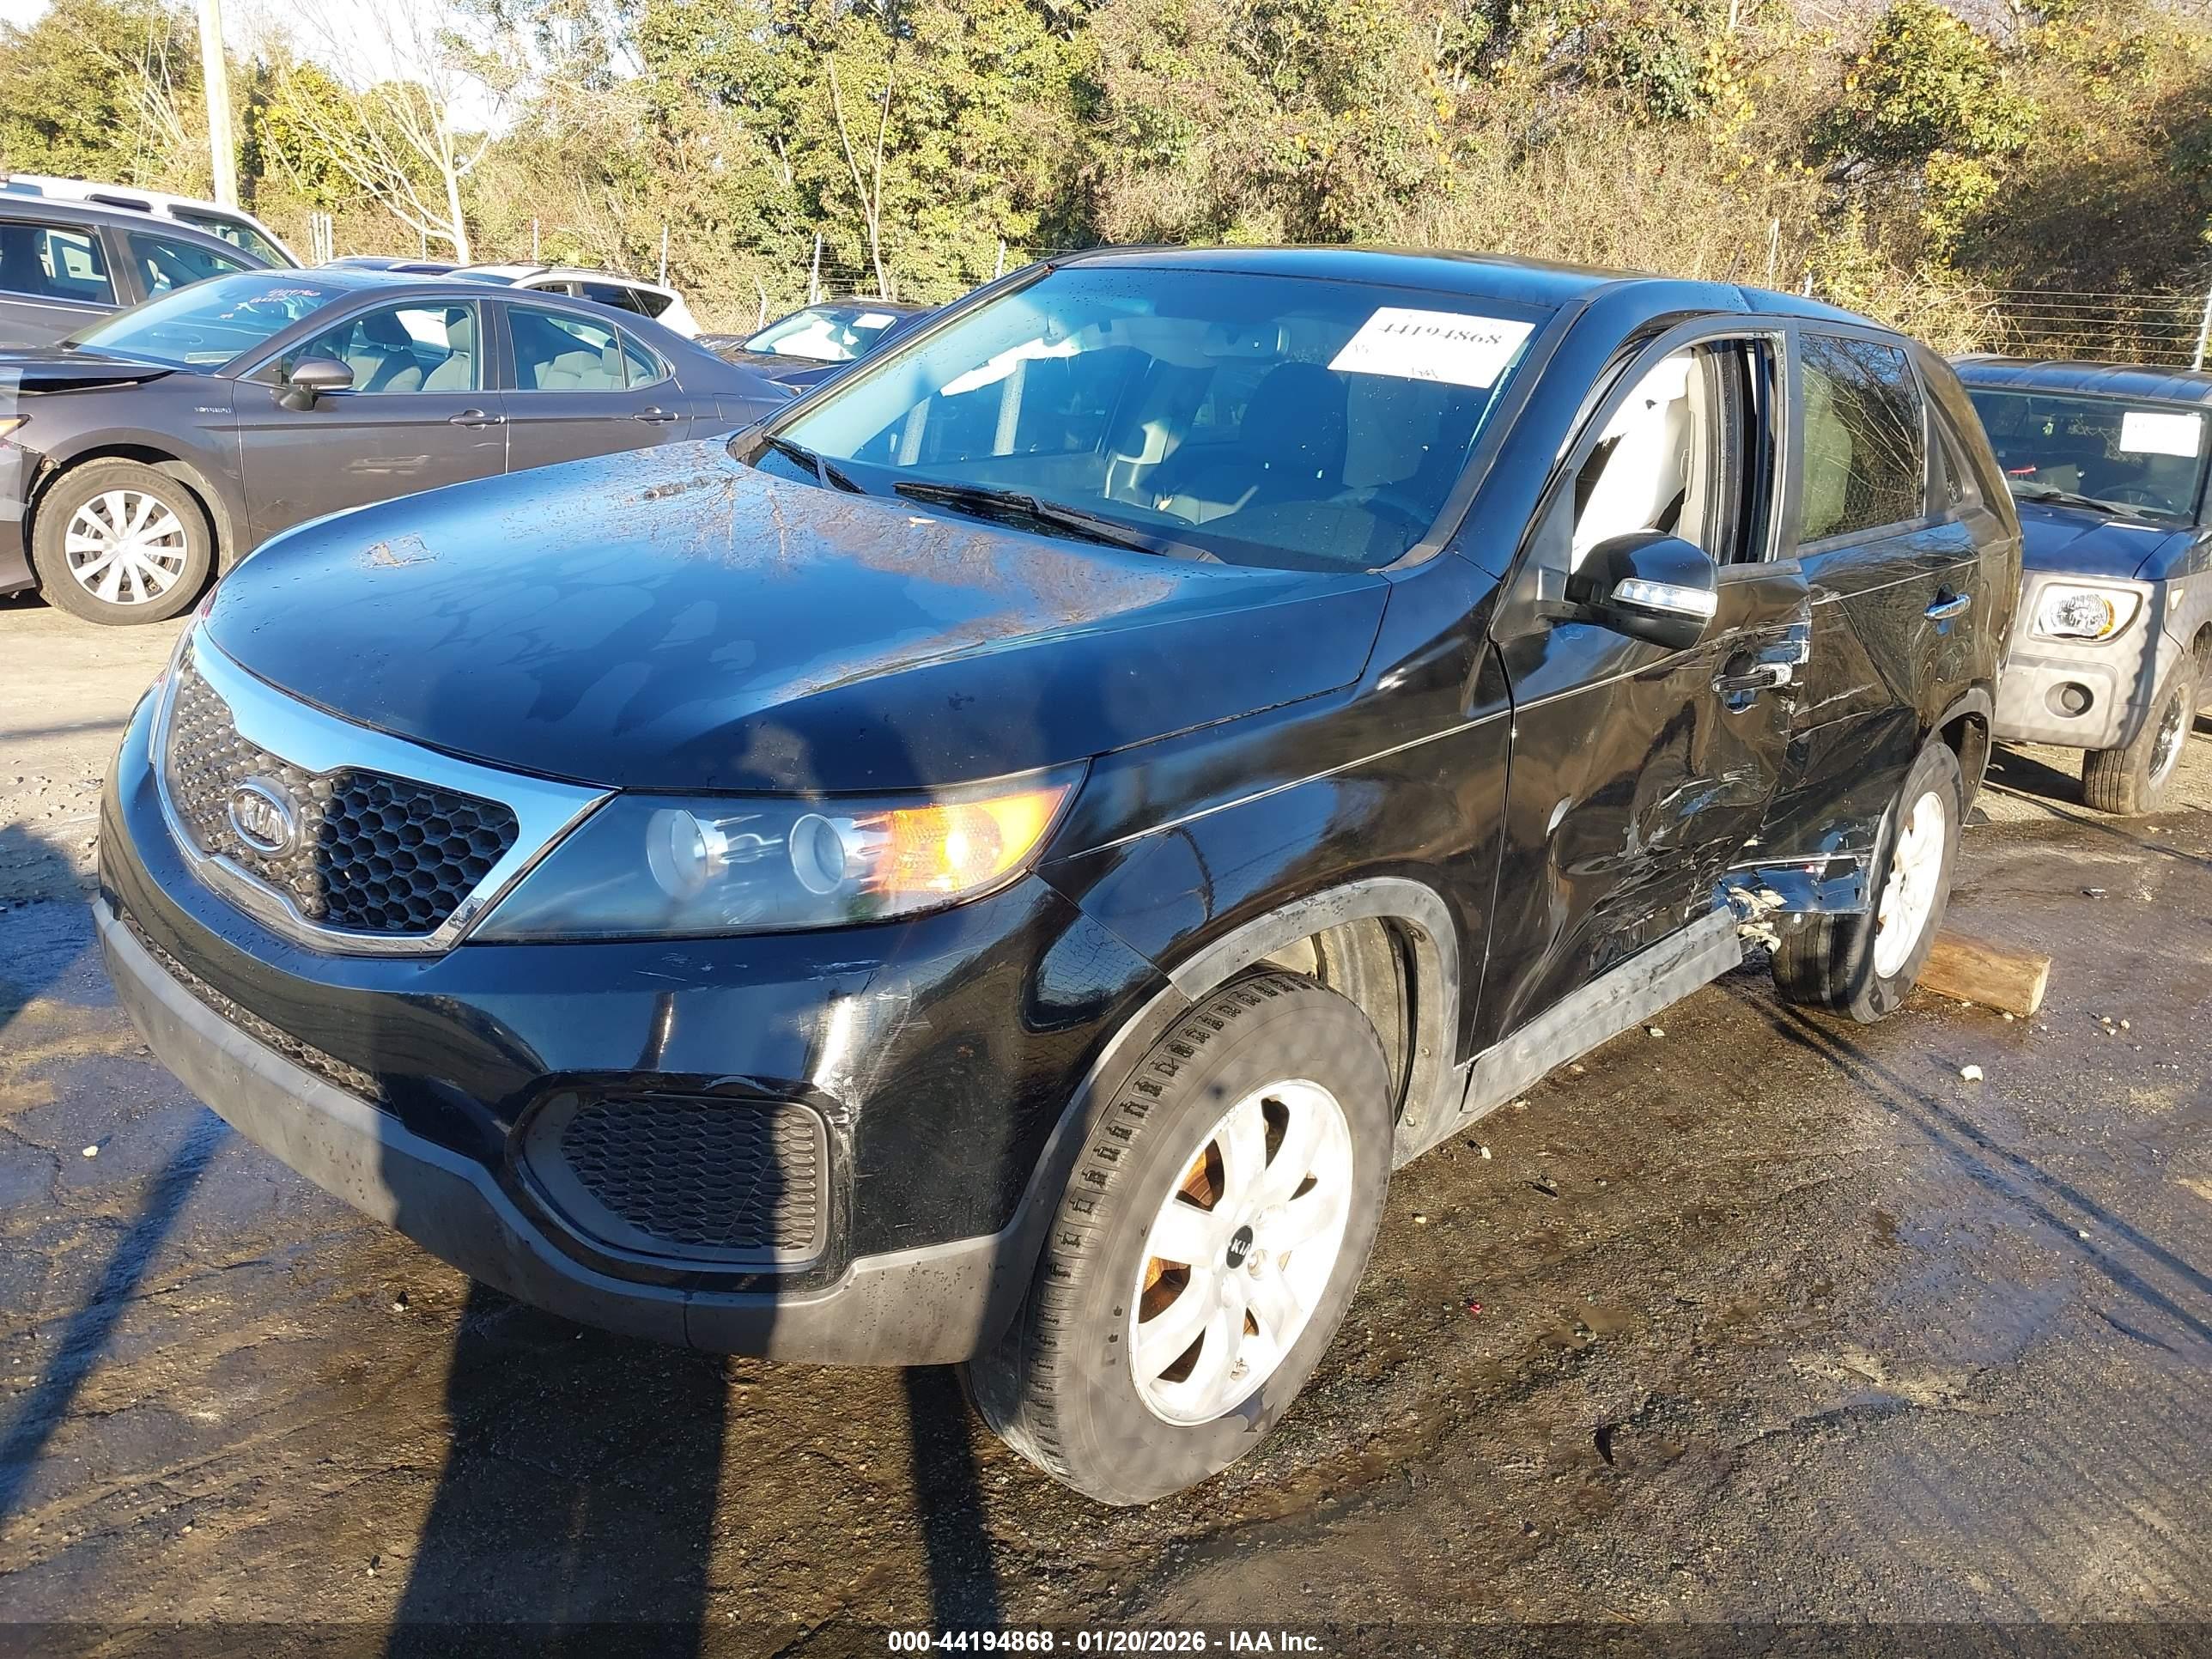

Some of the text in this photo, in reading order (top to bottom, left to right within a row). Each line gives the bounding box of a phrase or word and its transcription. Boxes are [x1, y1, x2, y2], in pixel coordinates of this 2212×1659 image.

[1378, 323, 1503, 344] 44194868
[242, 794, 285, 845] KIA
[1231, 1238, 1251, 1256] KIA
